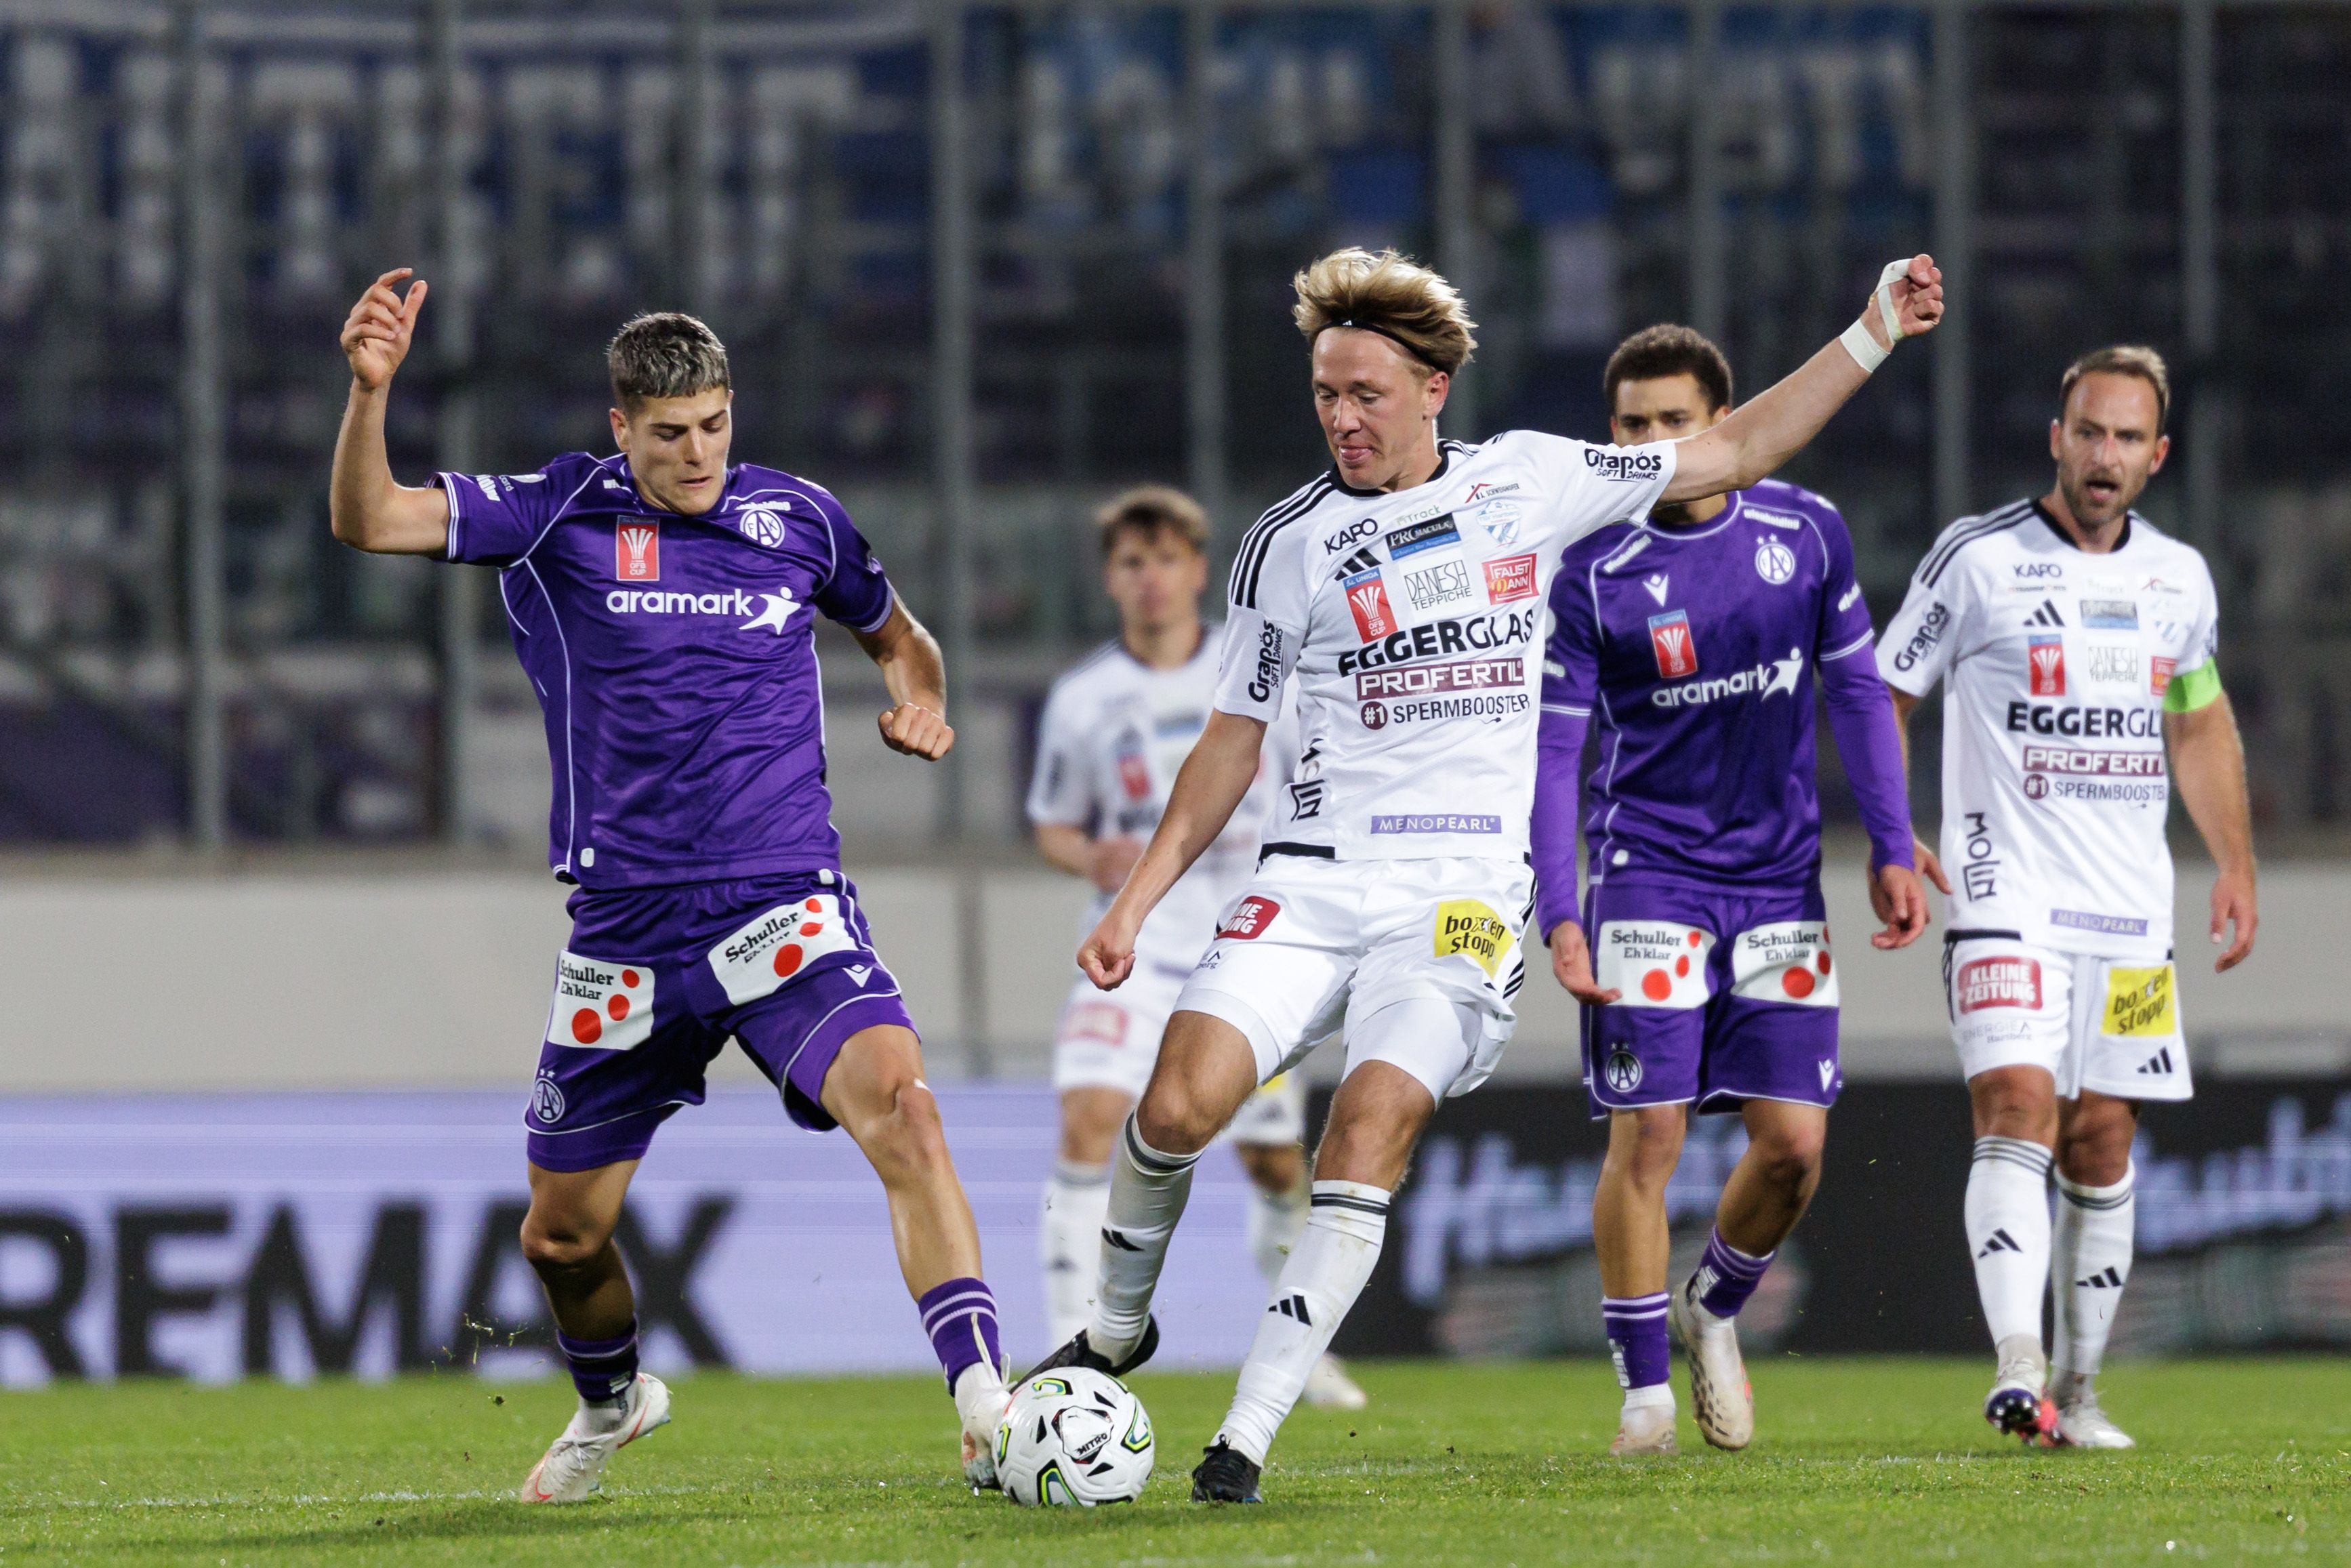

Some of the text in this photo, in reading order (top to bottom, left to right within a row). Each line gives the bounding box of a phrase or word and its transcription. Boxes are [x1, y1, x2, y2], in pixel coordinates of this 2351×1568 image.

[1596, 468, 1658, 480] SOFT DRINKS
[1324, 518, 1378, 555] KAPO
[1404, 560, 1470, 601] DANESH
[1494, 563, 1530, 579] FAUST
[2013, 564, 2062, 577] KAPO
[607, 588, 754, 617] aramark
[1412, 587, 1473, 611] TEPPICHE
[1370, 625, 1387, 636] CUP
[1338, 609, 1534, 678] EGGERGLAS
[1271, 665, 1280, 688] SOFT
[1652, 663, 1771, 707] aramark
[2090, 673, 2138, 683] TEPPICHE
[1364, 694, 1530, 724] #1 SPERMBOOSTER
[2007, 701, 2160, 739] EGGERGL
[2026, 748, 2164, 773] PROFERTI
[2026, 778, 2167, 802] #1 SPERMBOOSTE
[725, 912, 798, 963] Schuller
[1450, 932, 1495, 960] stopp
[1612, 929, 1681, 946] Schuller
[1747, 930, 1818, 949] Schuller
[560, 960, 614, 986] Schuller
[1969, 963, 2030, 985] KLEINE
[1965, 983, 2036, 1006] ZEITUNG
[2118, 994, 2165, 1035] stopp
